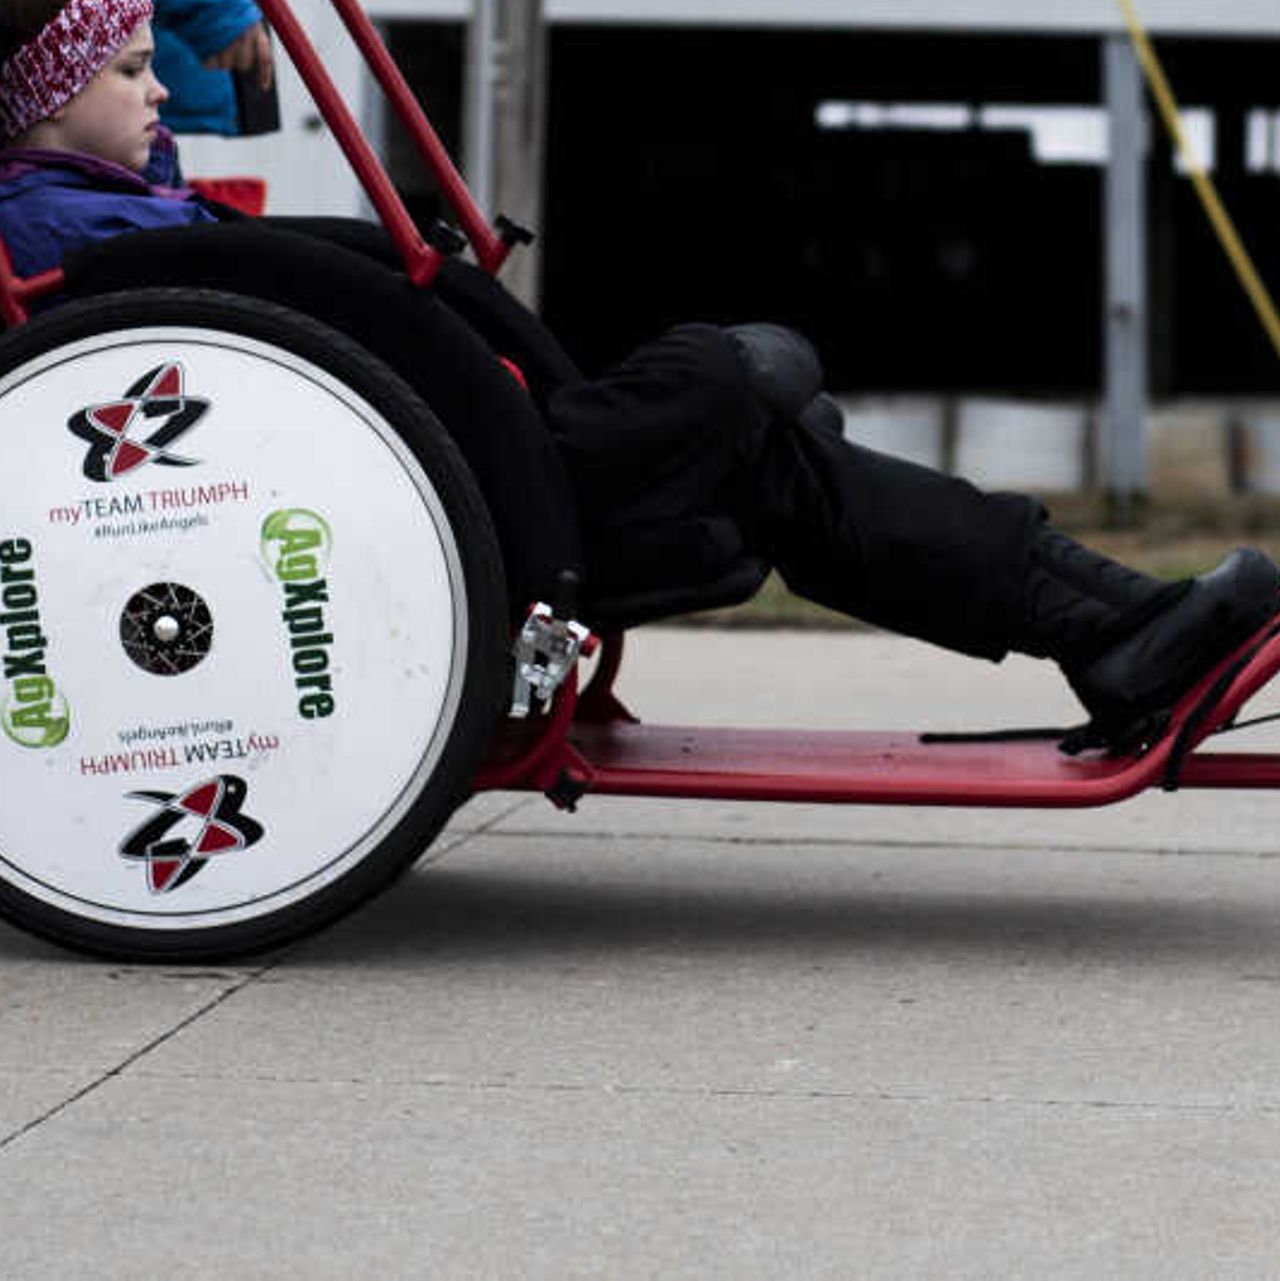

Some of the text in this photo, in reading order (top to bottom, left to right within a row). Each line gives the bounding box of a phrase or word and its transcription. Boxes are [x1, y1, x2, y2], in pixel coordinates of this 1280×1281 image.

[49, 481, 249, 526] myTEAM TRIUMPH
[274, 527, 336, 721] AgXplore
[79, 733, 281, 776] myTEAM TRIUMPH
